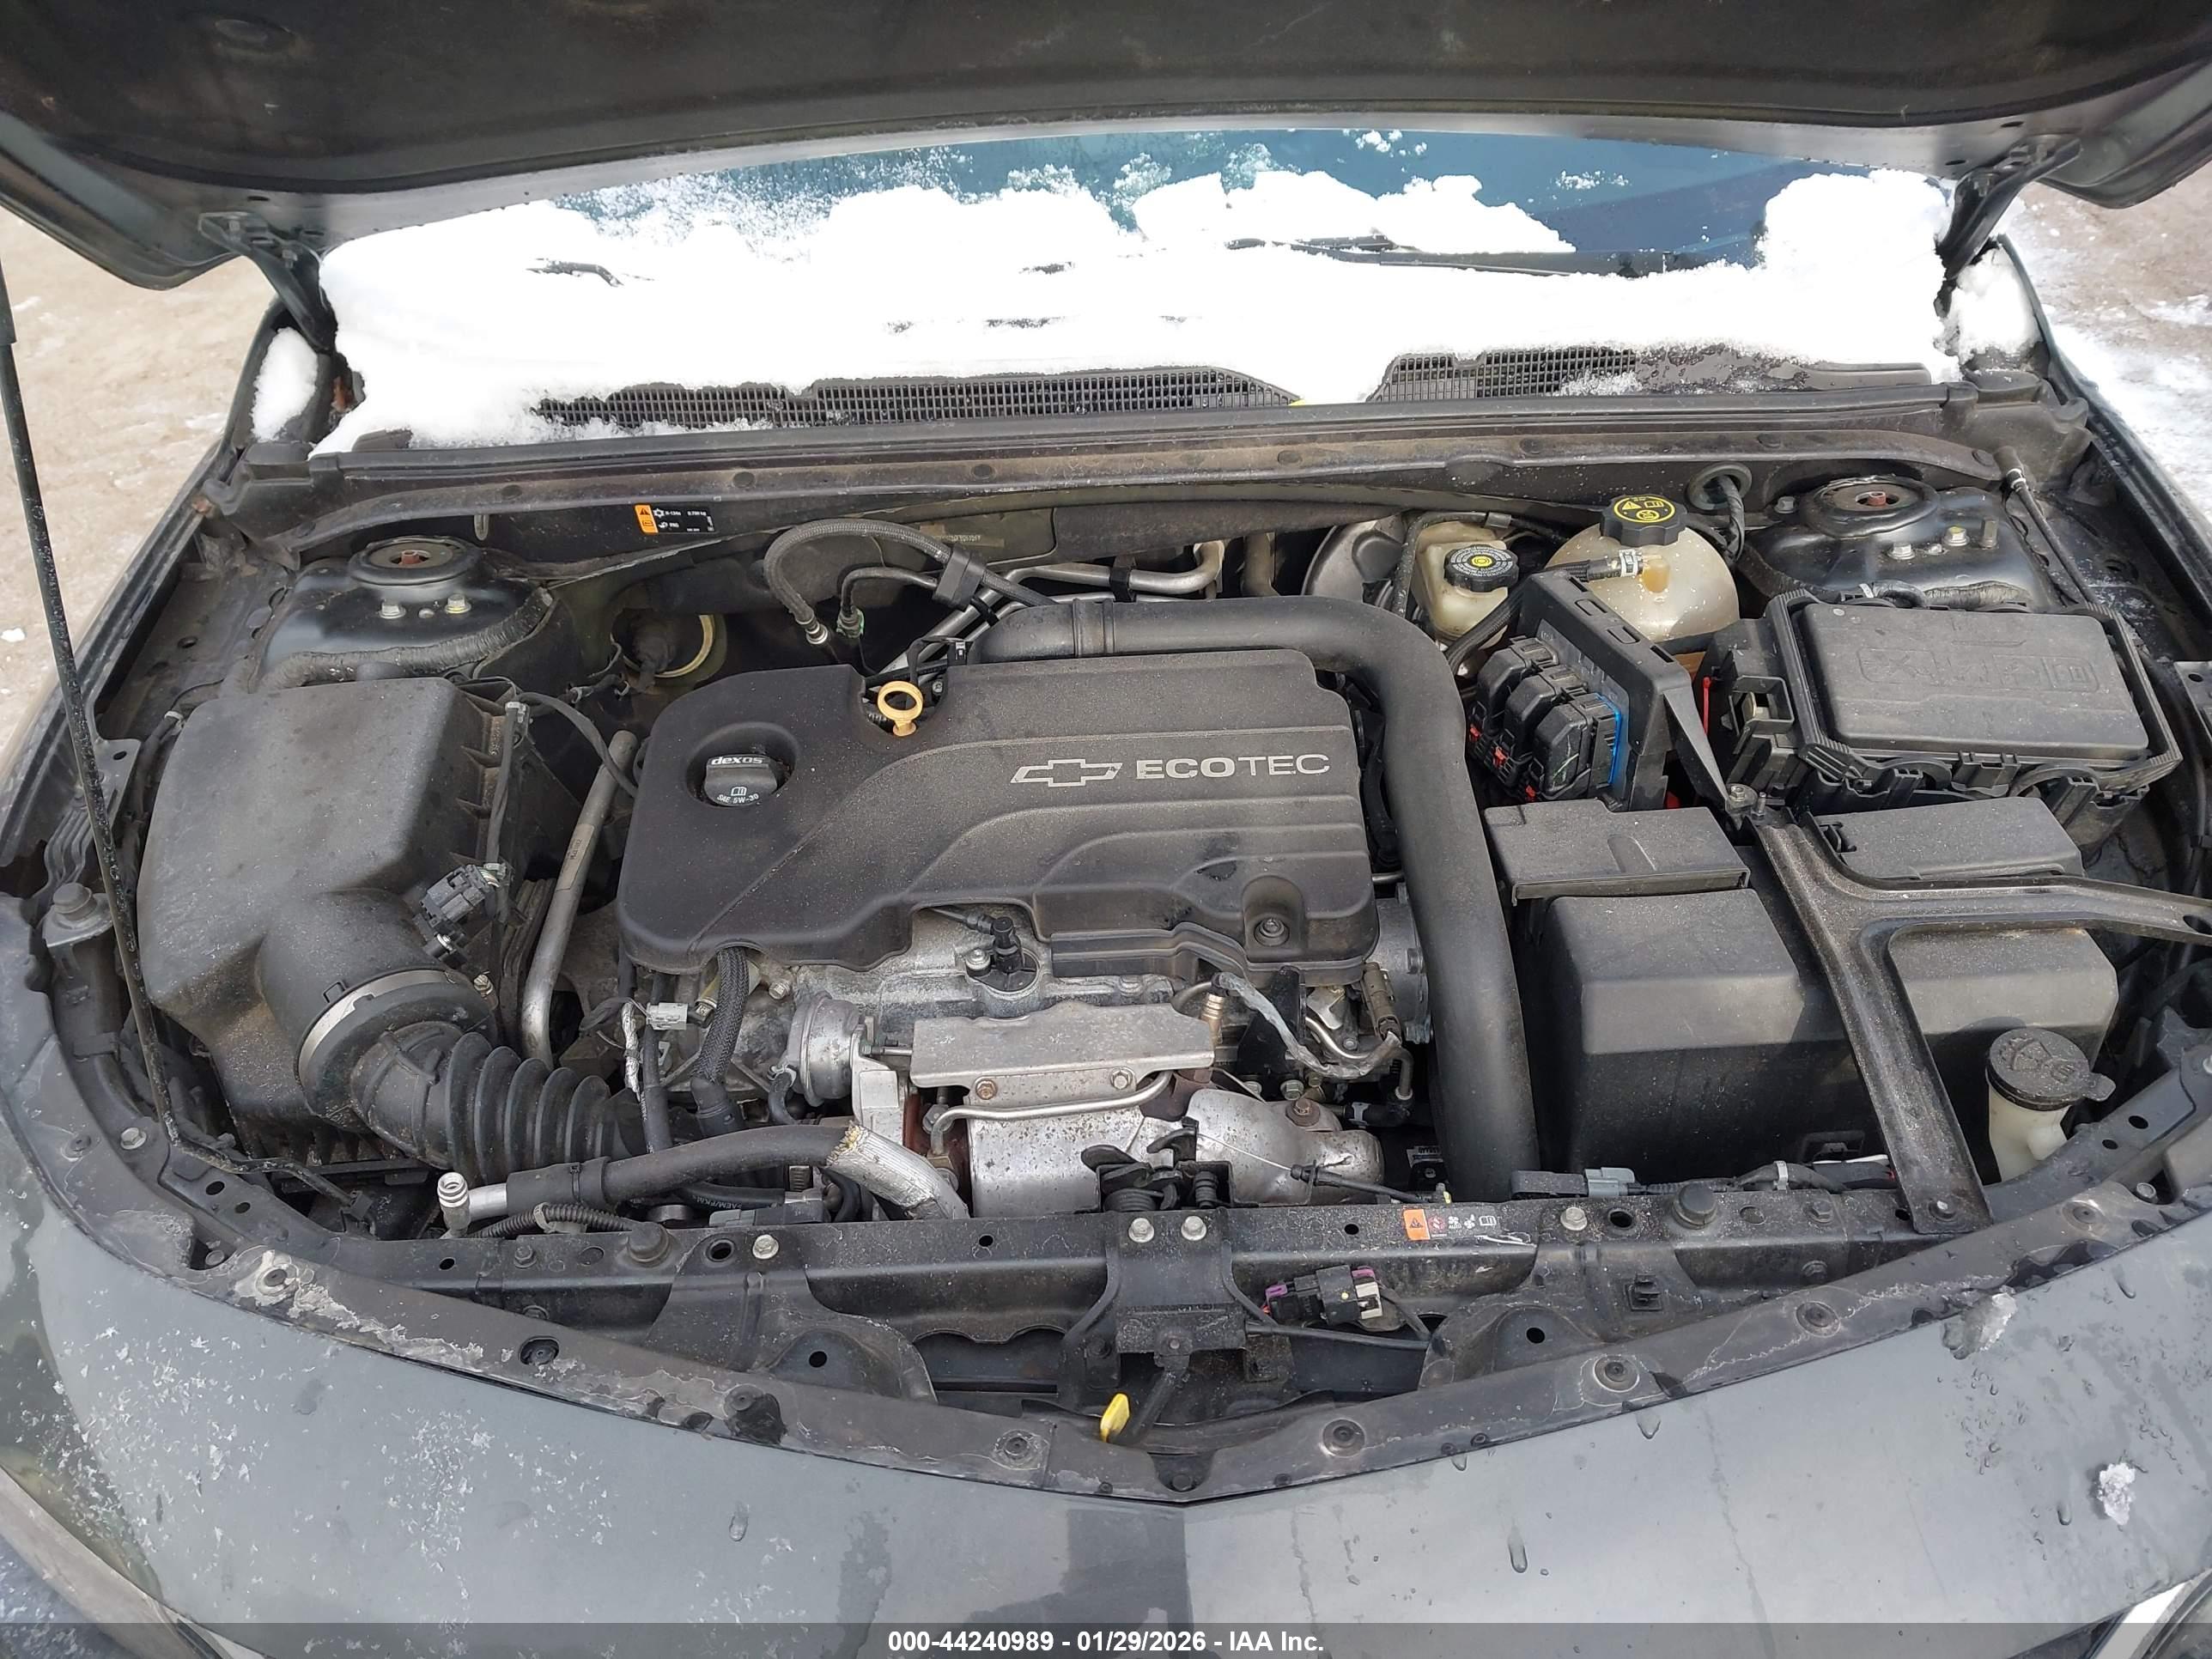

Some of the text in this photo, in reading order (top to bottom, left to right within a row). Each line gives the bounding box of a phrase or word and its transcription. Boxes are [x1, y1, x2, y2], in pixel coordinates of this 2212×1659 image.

[711, 757, 764, 765] dexos
[1136, 754, 1330, 780] ECOTEC
[732, 793, 759, 804] 5W-30
